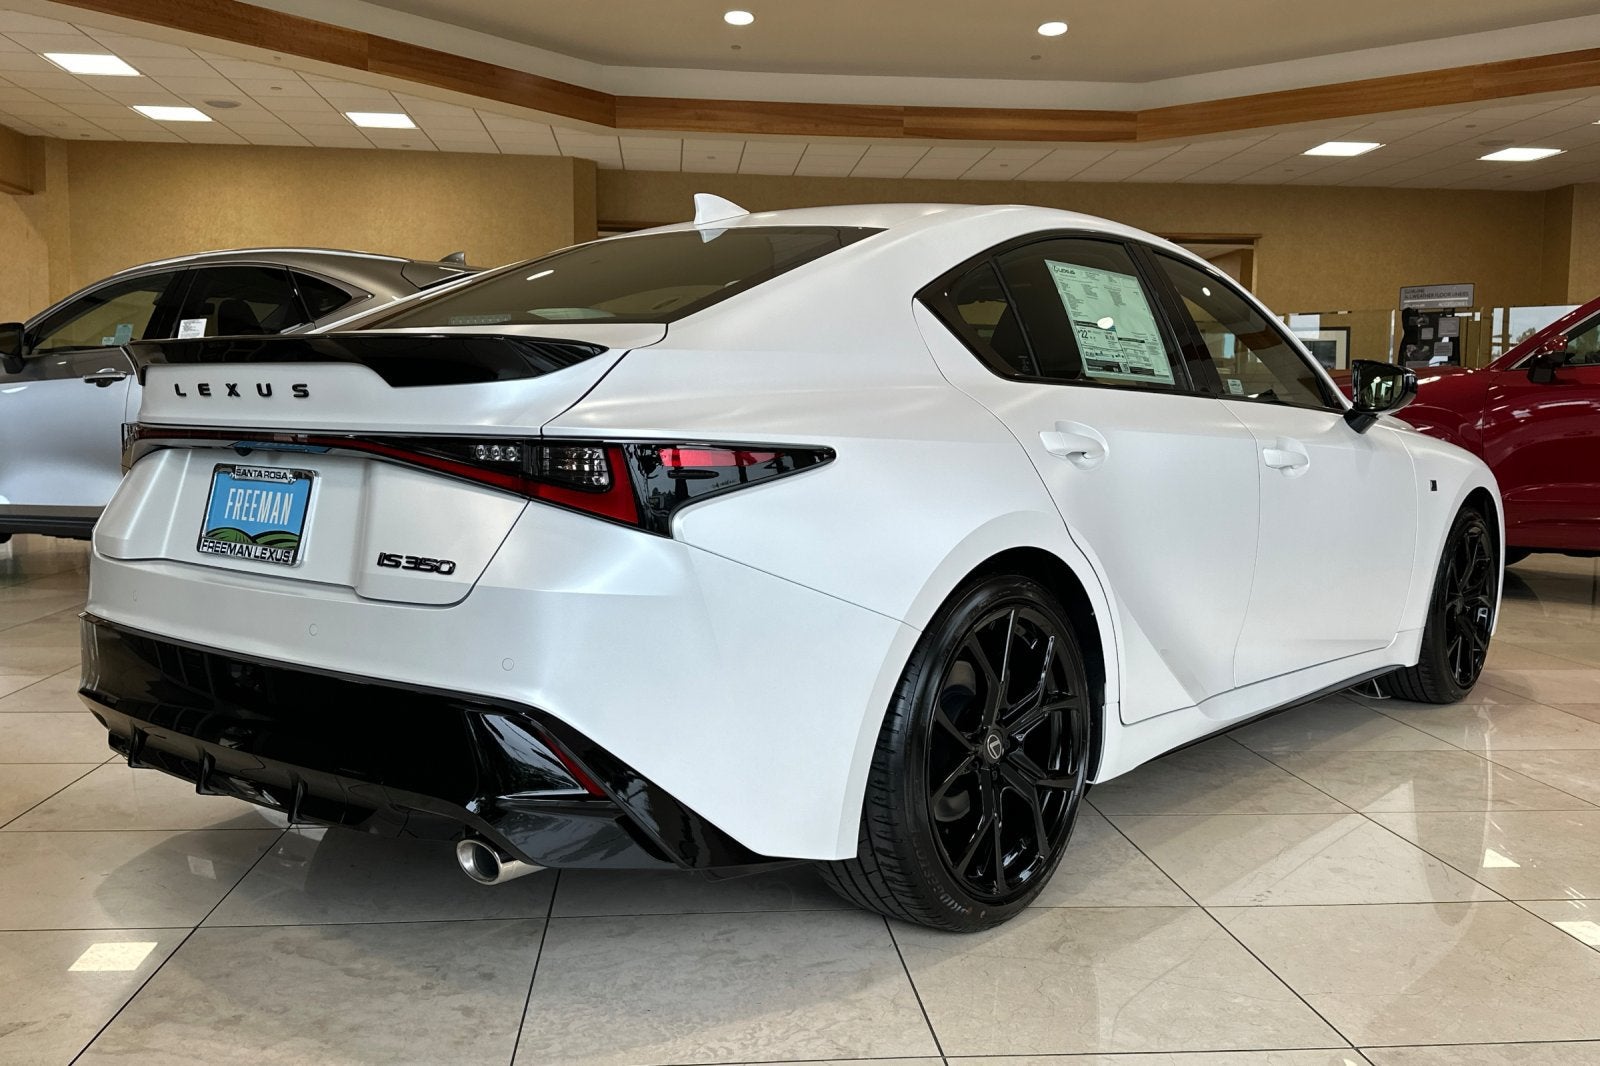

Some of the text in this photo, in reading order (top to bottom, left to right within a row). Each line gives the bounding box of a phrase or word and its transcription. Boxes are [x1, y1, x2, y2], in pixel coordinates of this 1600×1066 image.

[174, 382, 310, 398] LEXUS
[236, 468, 288, 480] SANTA ROSA
[224, 487, 294, 526] FREEMAN
[201, 540, 291, 563] FREEMAN LEXUS
